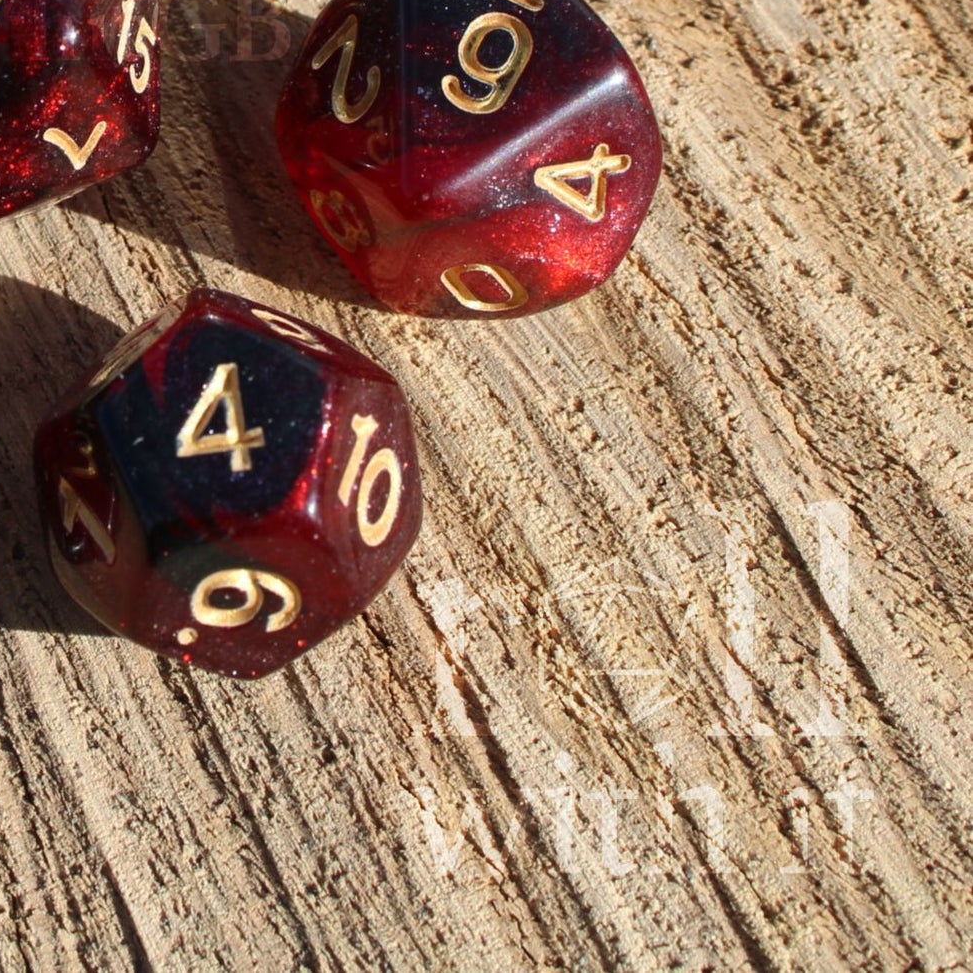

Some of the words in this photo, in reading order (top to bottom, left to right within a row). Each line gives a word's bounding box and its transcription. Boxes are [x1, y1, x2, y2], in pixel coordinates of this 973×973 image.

[311, 14, 381, 124] 2
[43, 121, 107, 170] 7
[534, 143, 632, 223] 4
[441, 263, 528, 312] 0
[176, 362, 265, 472] 4
[337, 413, 402, 547] 10
